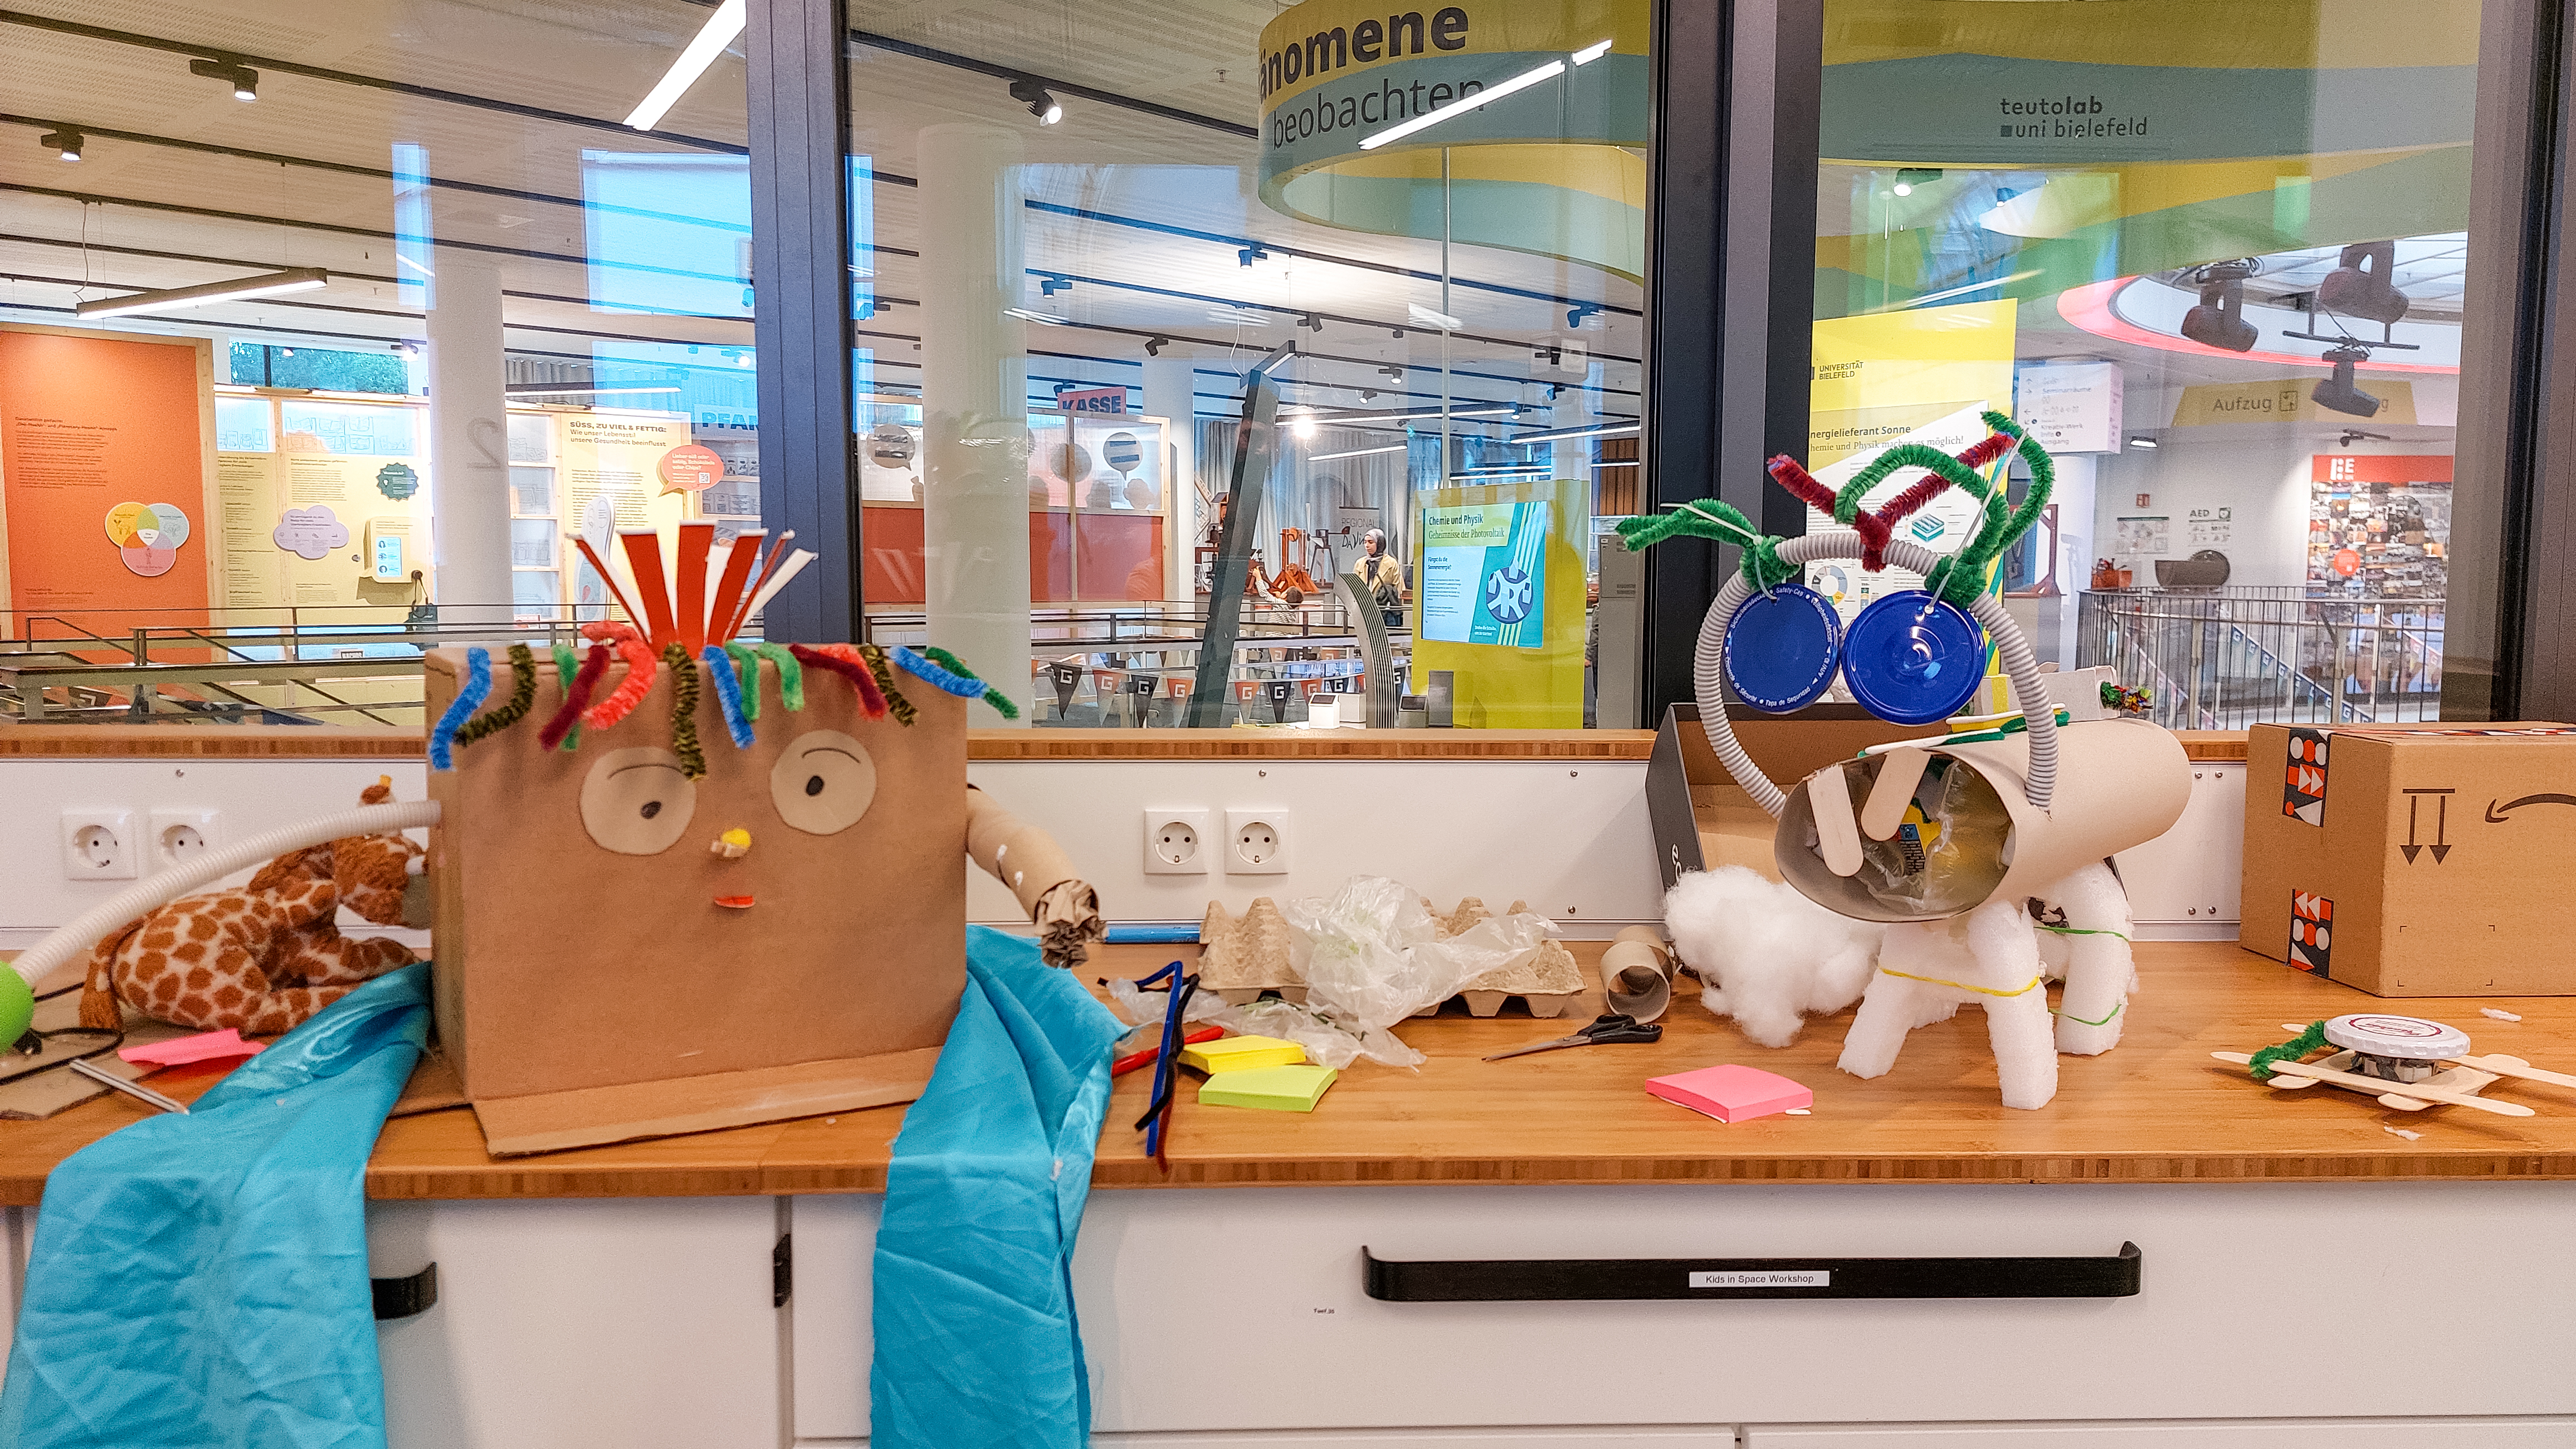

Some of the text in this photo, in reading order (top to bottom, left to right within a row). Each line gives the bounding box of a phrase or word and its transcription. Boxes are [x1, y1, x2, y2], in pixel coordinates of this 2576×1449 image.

[1999, 95, 2103, 115] teutolab
[1273, 78, 1485, 151] beobachten
[2015, 116, 2148, 138] uni bielefeld
[1819, 360, 1864, 372] UNIVERSITÄT
[1819, 371, 1855, 380] BIELEFELD
[2213, 396, 2273, 413] Aufzug
[570, 421, 594, 430] SÜSS,
[1811, 426, 1911, 440] nergielieferant Sonne
[1811, 441, 1834, 452] hemie
[1836, 441, 1851, 451] und
[1854, 440, 1880, 452] Physik
[1926, 435, 1964, 447] möglich!
[1428, 514, 1484, 526] Chemie und Physik
[1428, 527, 1505, 539] Geheimnisse der Photovoltaik
[1776, 587, 1804, 597] Safety-Cap
[1730, 593, 1766, 629] Sicherheitsdecke
[1060, 669, 1073, 684] G
[1101, 676, 1114, 691] G
[1138, 680, 1149, 695] G
[1175, 684, 1186, 698] G
[1274, 685, 1285, 700] G
[1334, 679, 1344, 692] G
[1242, 686, 1253, 700] G
[1765, 699, 1777, 708] Tapa
[1787, 685, 1811, 704] Seguridad
[1705, 1274, 1814, 1285] Kids in Space Workshop
